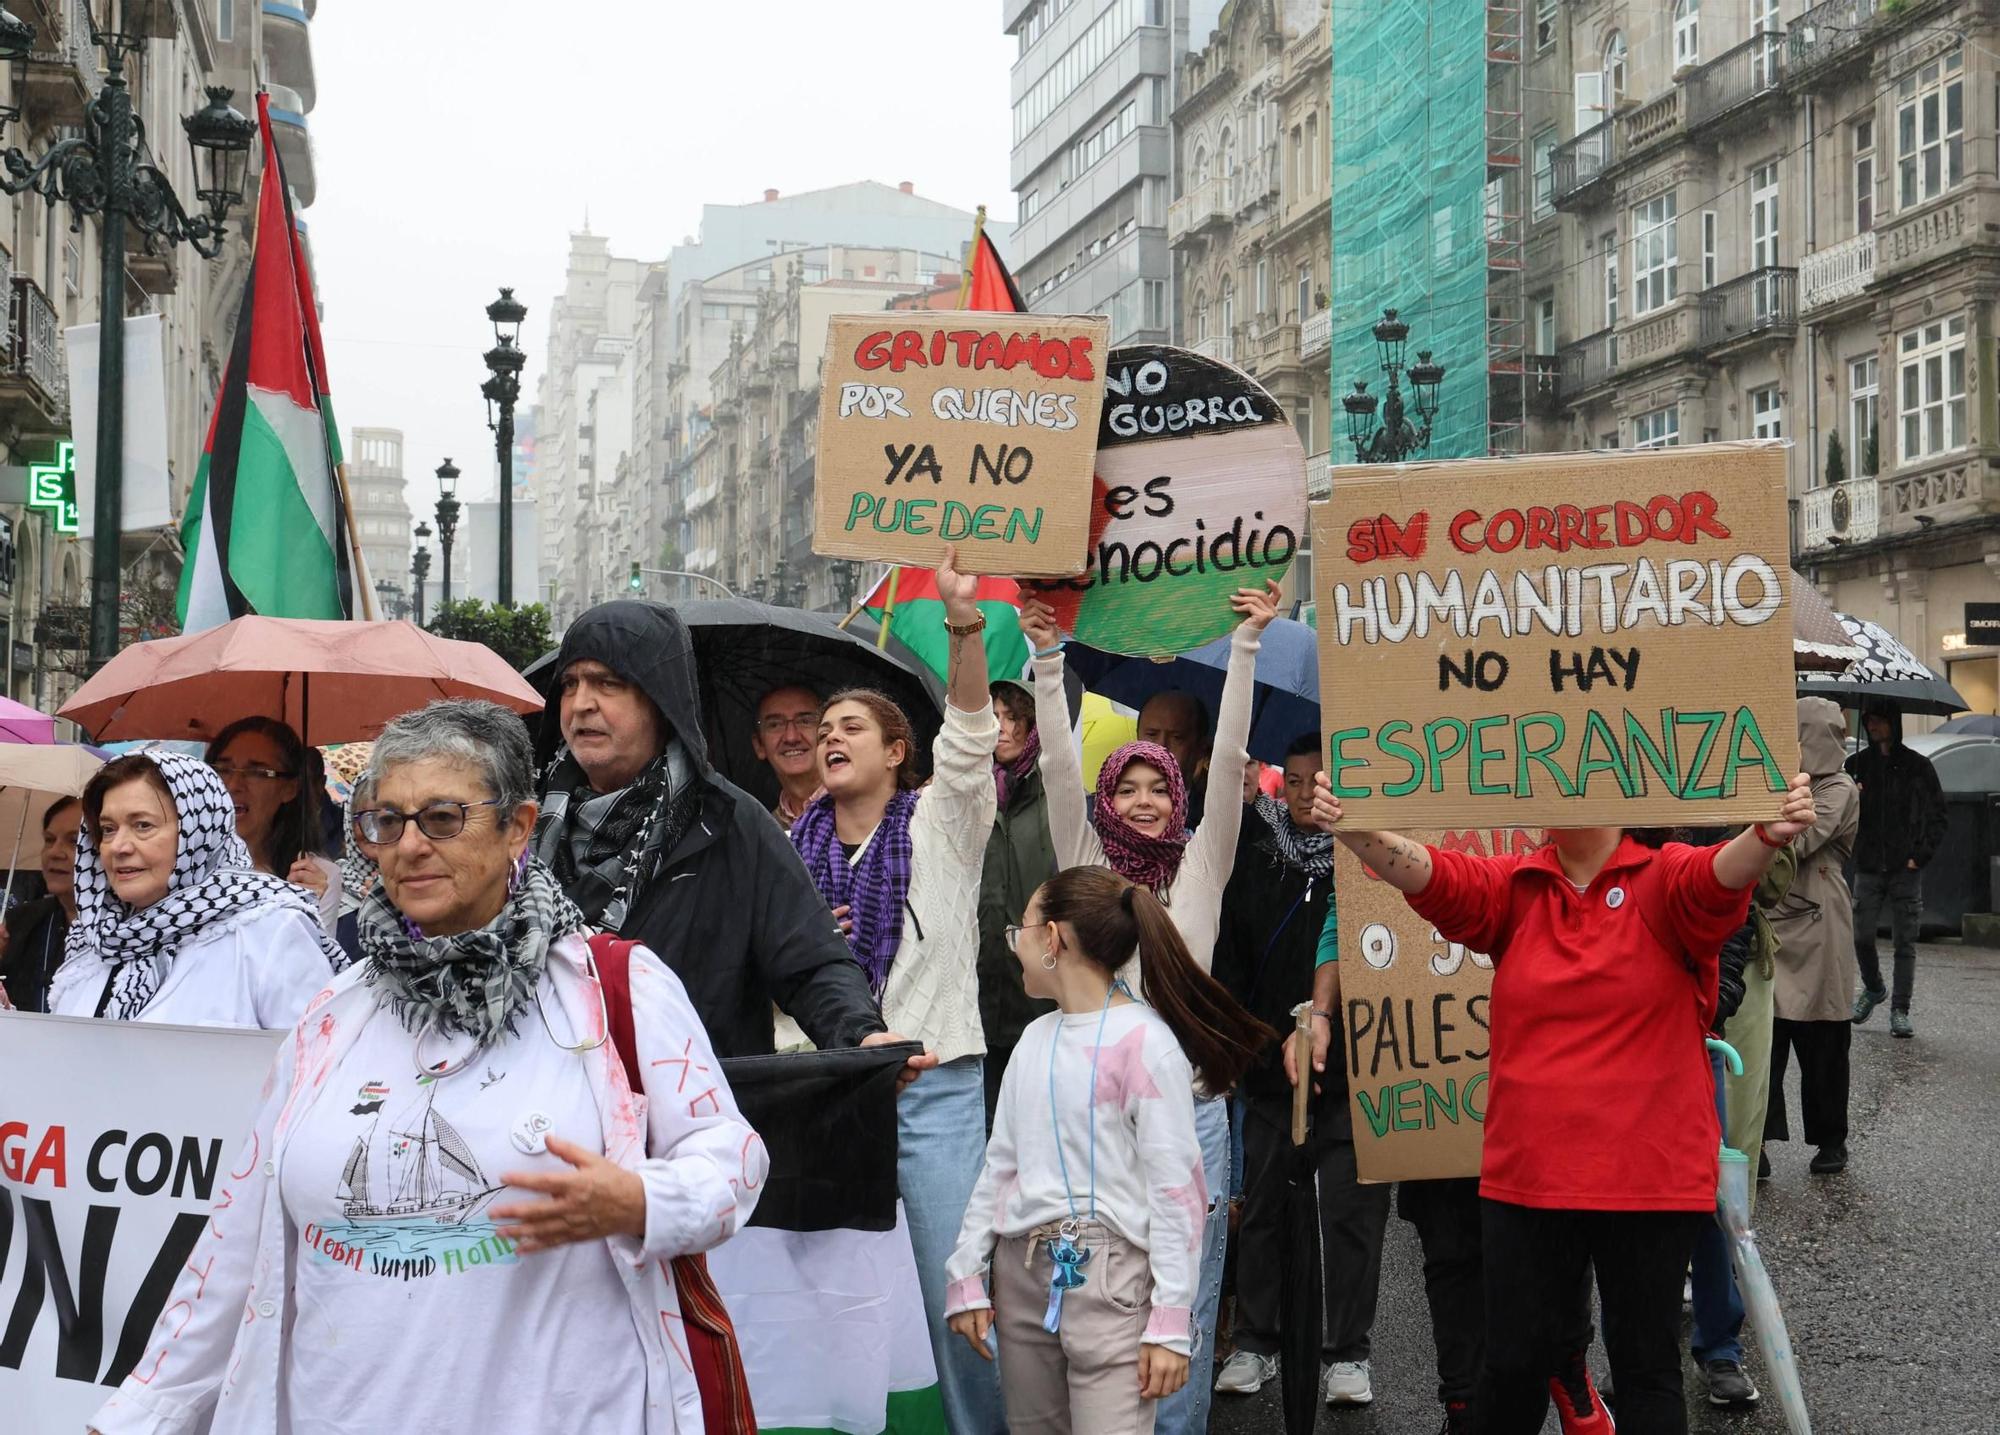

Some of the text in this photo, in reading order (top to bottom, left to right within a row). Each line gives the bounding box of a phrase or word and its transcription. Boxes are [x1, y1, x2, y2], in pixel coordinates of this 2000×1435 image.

[854, 329, 1095, 381] GRITAMOS
[1103, 360, 1168, 397] NO
[839, 383, 1078, 431] POR QUIENES
[884, 443, 1034, 485] YA NO
[845, 492, 1044, 544] PUEDEN
[1105, 476, 1175, 520] es
[1030, 511, 1297, 590] nocidio
[1346, 491, 1731, 563] SIN CORREDOR
[1333, 553, 1783, 646] HUMANITARIO
[1439, 646, 1641, 692] NO HAY
[1331, 706, 1789, 800] ESPERANZA
[1348, 994, 1490, 1078] PALES
[0, 1121, 223, 1200] GA CON
[370, 1252, 436, 1281] SUMUD
[443, 1236, 516, 1275] FLOTIL
